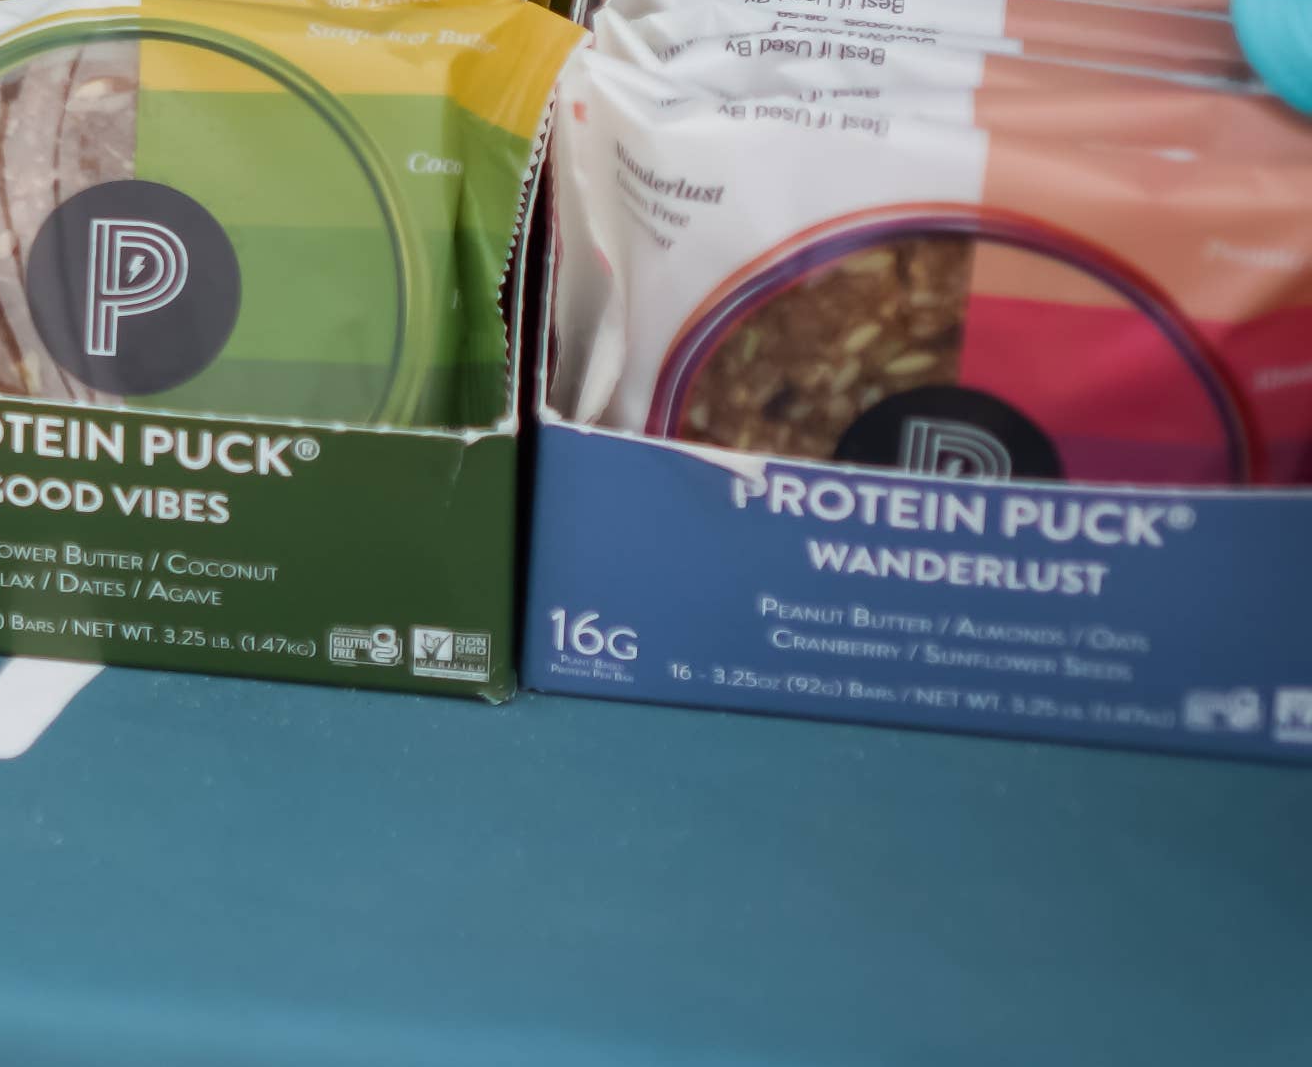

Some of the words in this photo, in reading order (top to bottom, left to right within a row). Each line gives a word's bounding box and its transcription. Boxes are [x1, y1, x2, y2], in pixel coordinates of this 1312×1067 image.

[725, 39, 752, 57] By
[760, 38, 813, 59] Used
[839, 42, 886, 66] Best
[87, 217, 189, 357] P
[112, 485, 231, 524] VIBES
[732, 474, 987, 536] PROTEIN
[807, 539, 1110, 596] WANDERLUST
